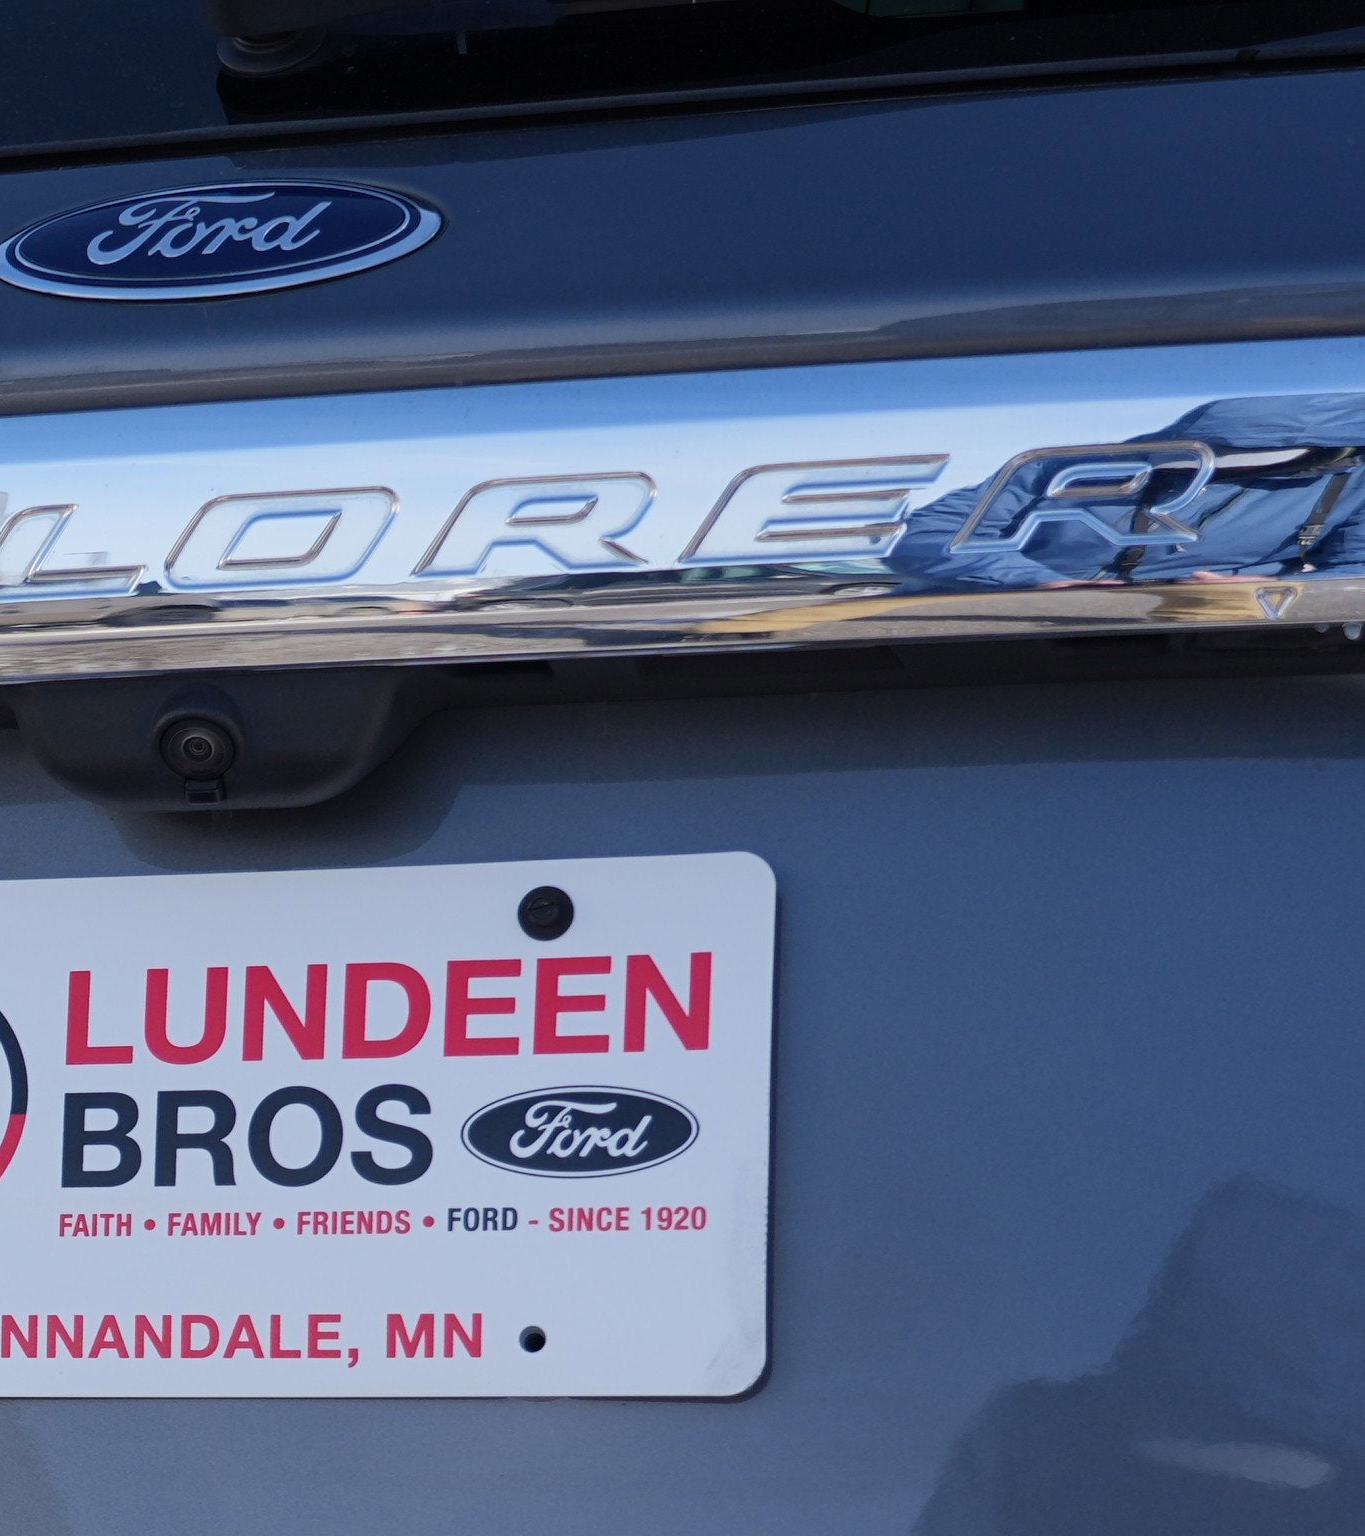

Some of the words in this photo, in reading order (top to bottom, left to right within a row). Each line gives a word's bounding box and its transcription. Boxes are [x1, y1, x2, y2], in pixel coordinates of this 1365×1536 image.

[86, 190, 332, 266] Ford
[65, 951, 713, 1066] LUNDEEN
[61, 1083, 434, 1189] BROS
[509, 1100, 653, 1159] Ford
[59, 1213, 132, 1238] FAITH
[167, 1211, 262, 1237] FAMILY
[297, 1209, 411, 1236] FRIENDS
[447, 1206, 519, 1232] FORD
[548, 1205, 630, 1233] SINCE
[641, 1204, 707, 1231] 1920
[386, 1312, 483, 1360] MN
